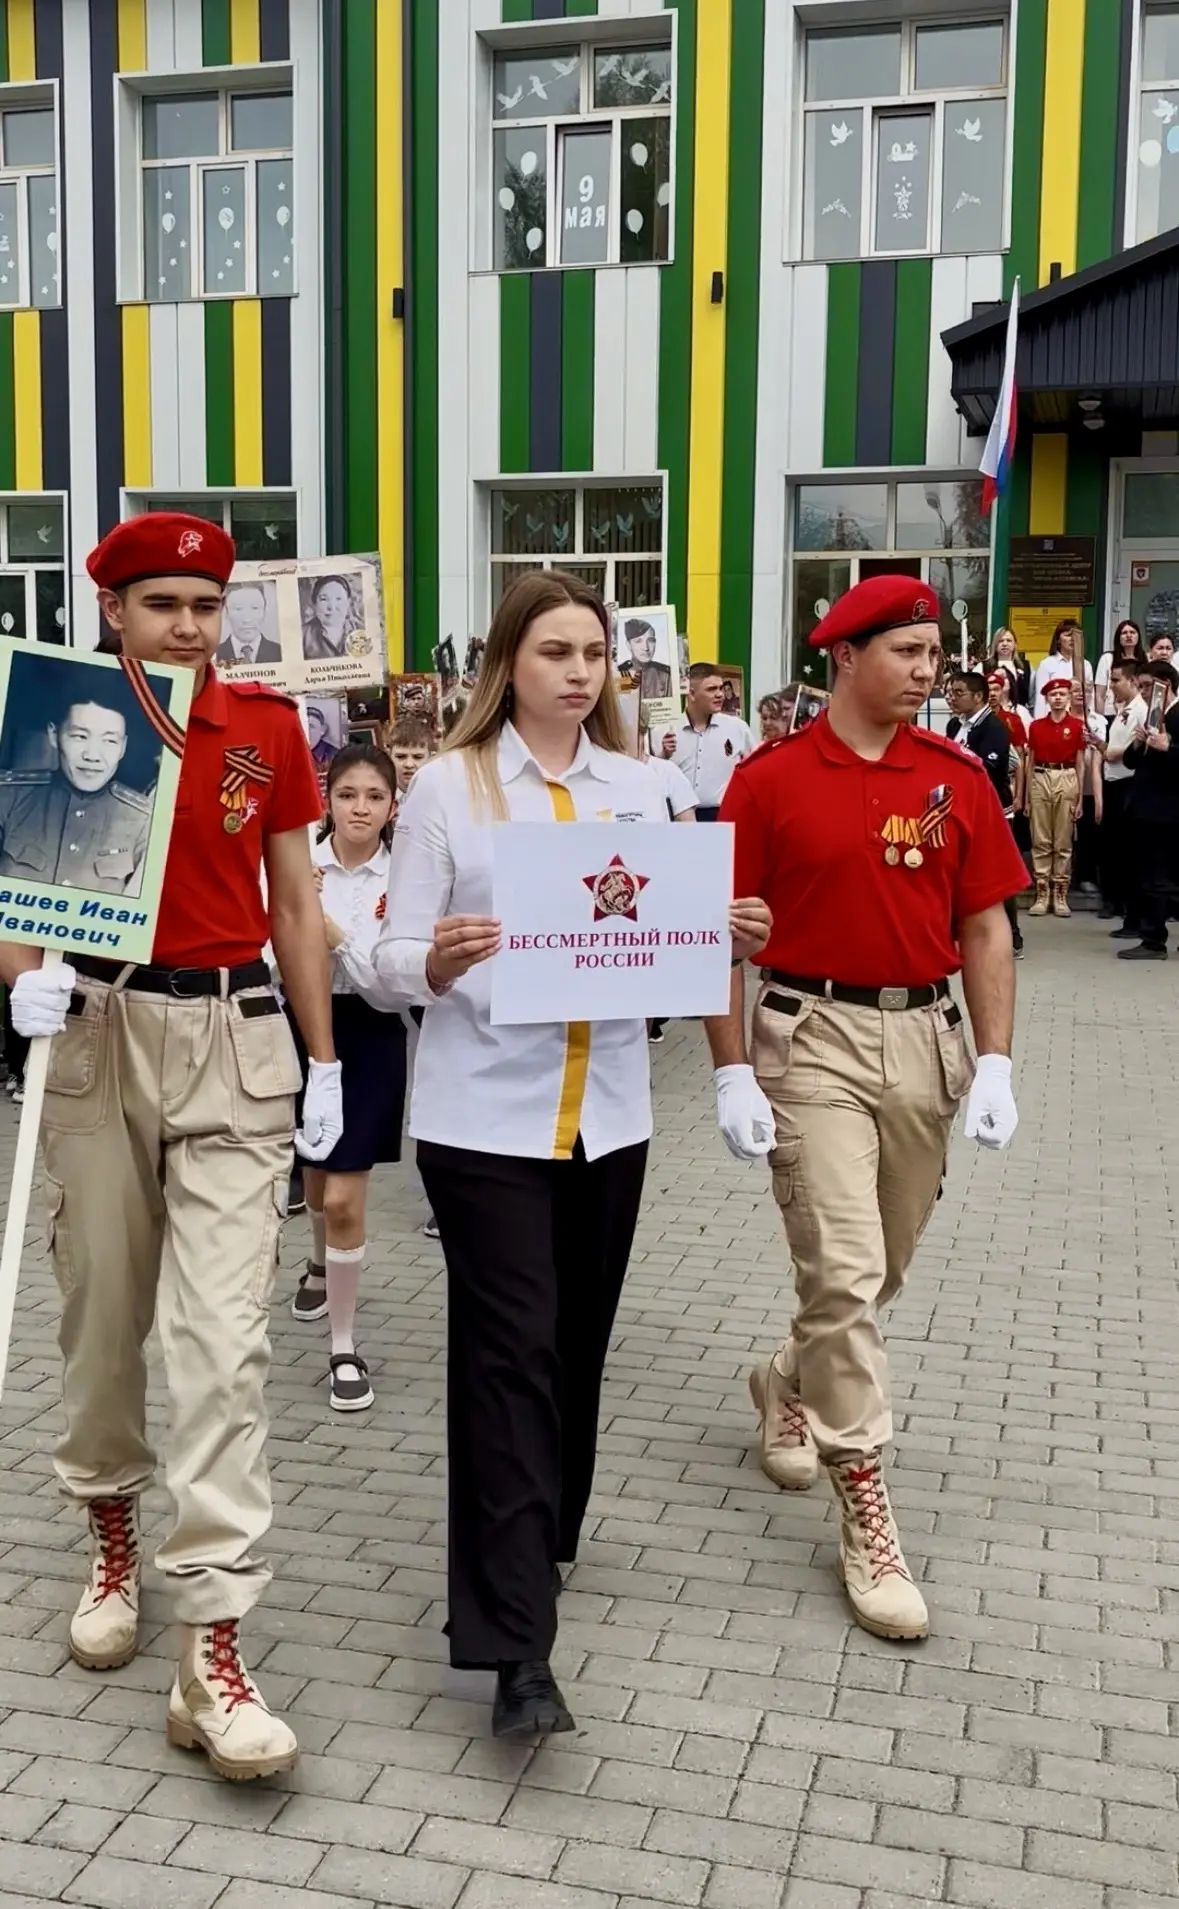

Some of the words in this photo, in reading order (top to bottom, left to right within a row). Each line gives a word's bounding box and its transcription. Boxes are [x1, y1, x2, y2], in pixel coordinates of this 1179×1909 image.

[579, 175, 594, 203] 9
[225, 669, 277, 680] МАЛЧИНОВ
[79, 899, 149, 927] Иван
[508, 928, 661, 950] БЕССМЕРТНЫЙ
[666, 930, 722, 946] ПОЛК
[574, 952, 655, 970] РОССИИ
